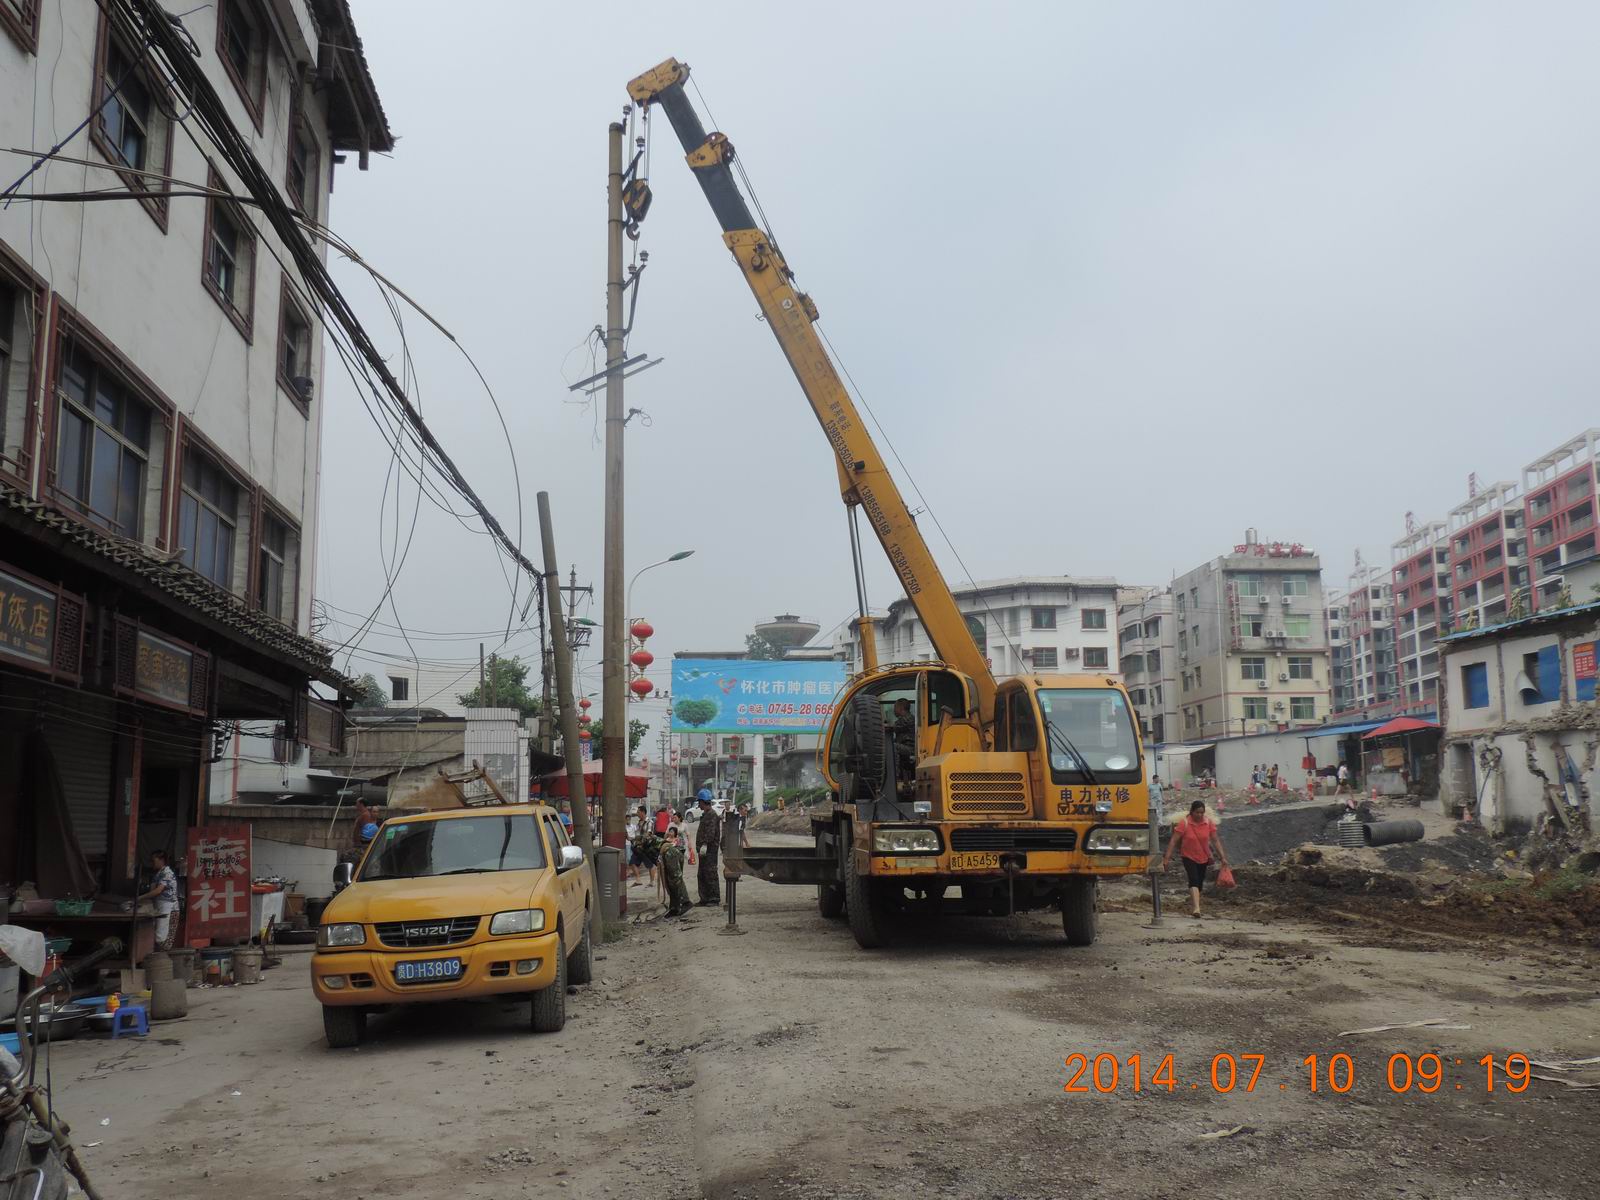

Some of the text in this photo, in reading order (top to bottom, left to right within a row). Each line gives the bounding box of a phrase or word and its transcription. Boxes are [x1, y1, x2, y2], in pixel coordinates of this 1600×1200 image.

[1061, 787, 1130, 804] 电力抢修
[405, 925, 449, 937] ISUZU
